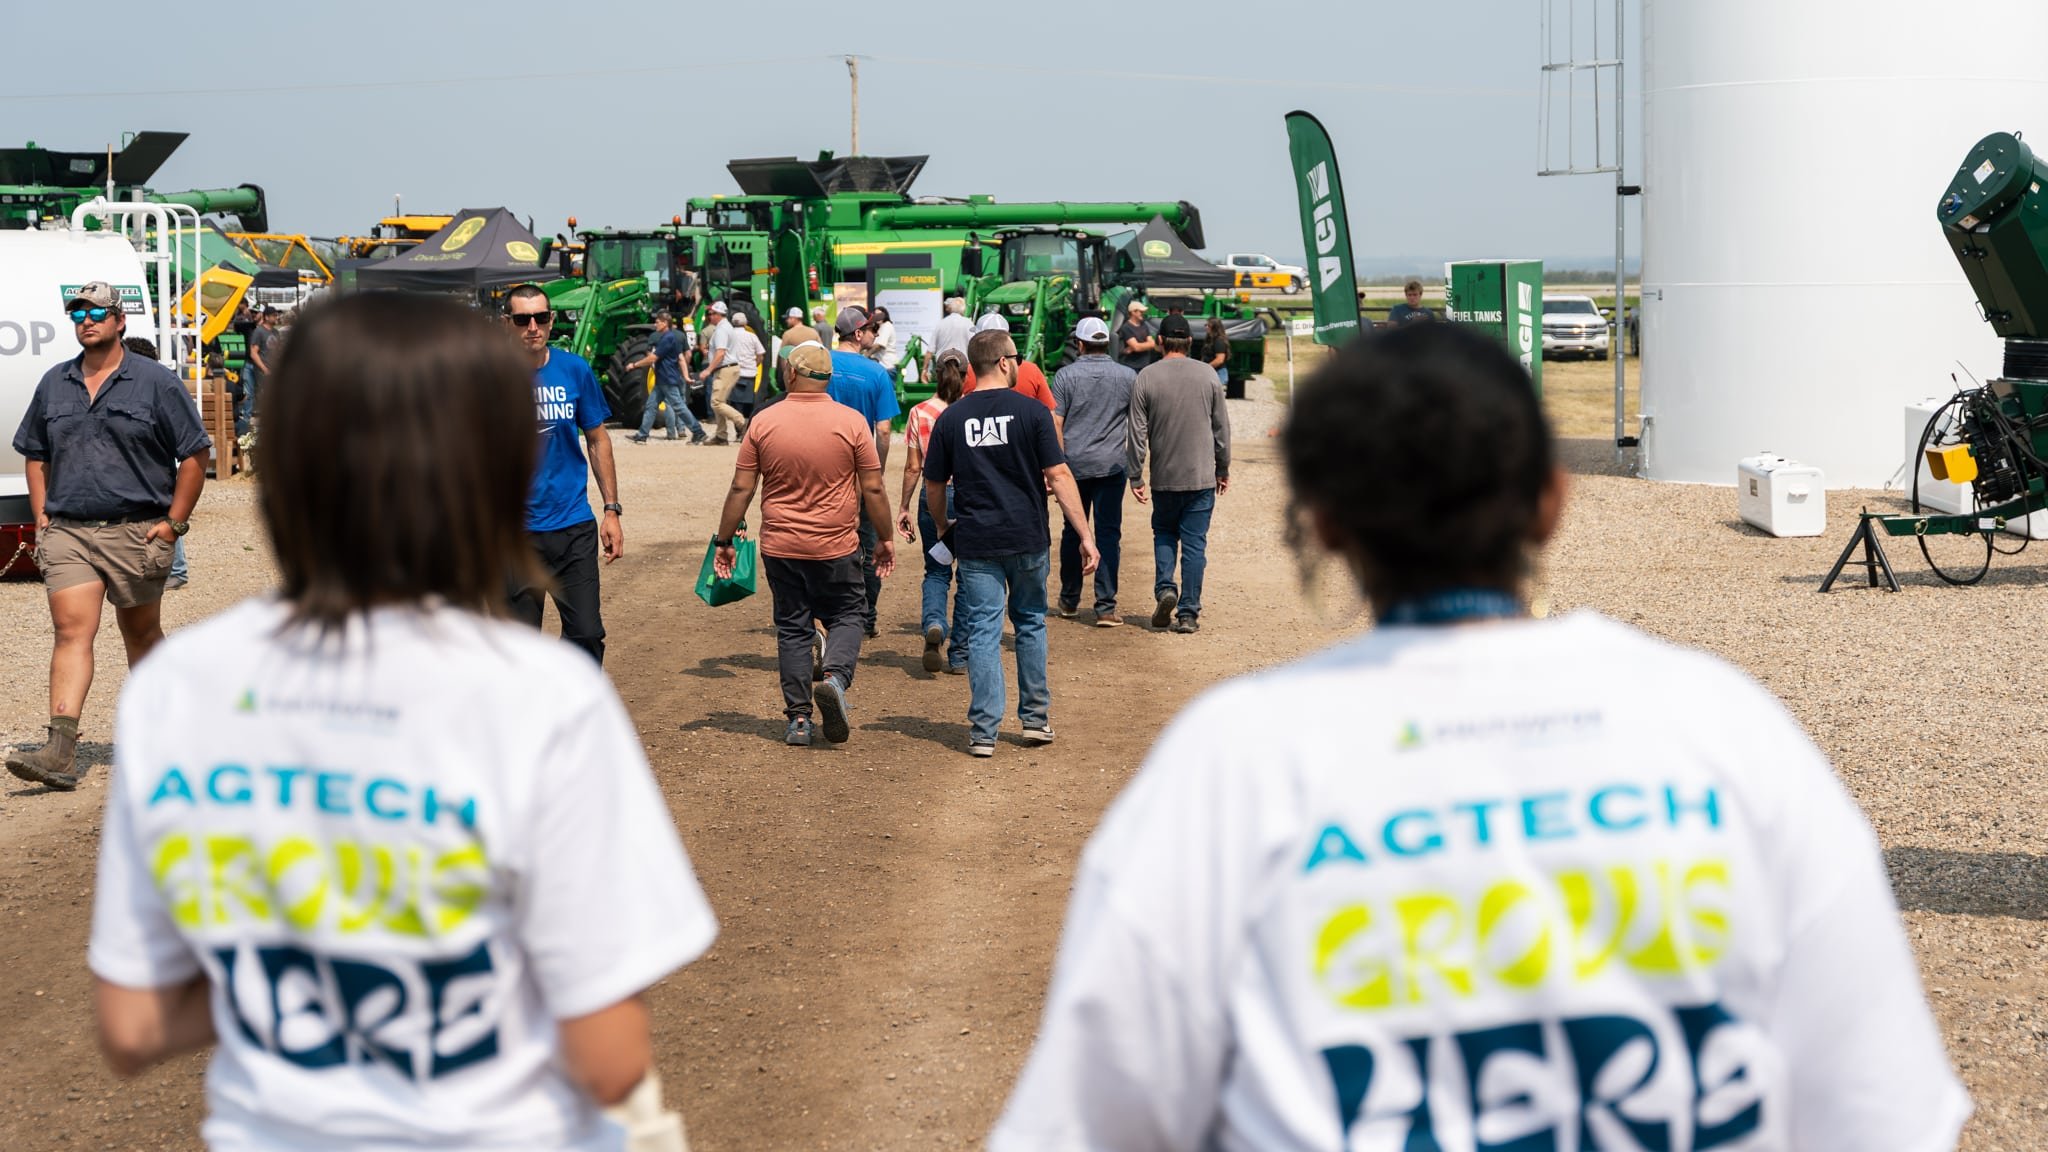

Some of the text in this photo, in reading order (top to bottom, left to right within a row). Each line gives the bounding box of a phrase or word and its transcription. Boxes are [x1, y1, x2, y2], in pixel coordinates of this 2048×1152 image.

[900, 275, 936, 284] TRACTORS
[1312, 200, 1342, 293] AGI
[1453, 310, 1502, 323] FUEL TANKS
[536, 403, 574, 420] NING
[964, 415, 1010, 448] CAT
[150, 764, 478, 828] AGTECH
[1302, 783, 1724, 878] AGTECH
[151, 834, 486, 936] GROWS
[1314, 861, 1728, 1012] GROWS
[208, 938, 501, 1084] HERE
[1318, 1002, 1768, 1152] HERE
